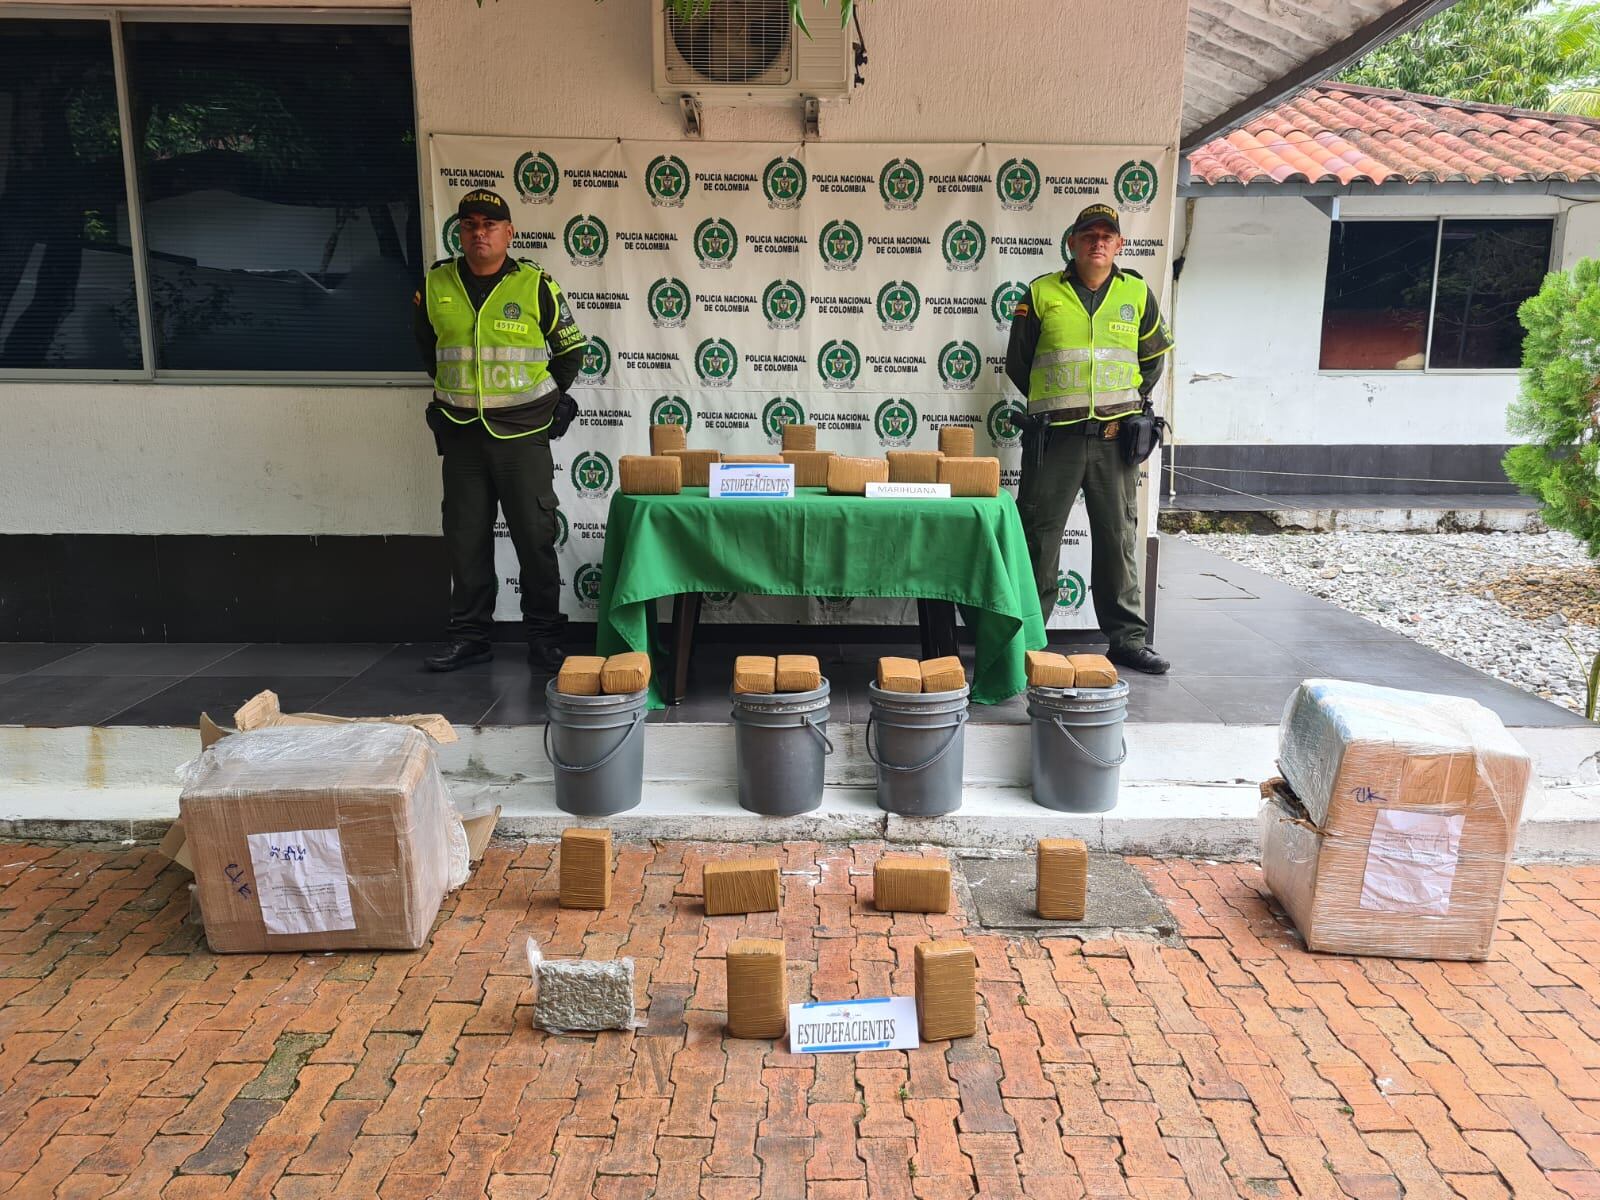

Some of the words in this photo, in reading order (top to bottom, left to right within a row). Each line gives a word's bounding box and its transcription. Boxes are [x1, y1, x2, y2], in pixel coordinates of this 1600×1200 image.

[440, 168, 468, 177] POLICIA
[469, 169, 505, 178] NACIONAL
[564, 170, 591, 178] POLICIA
[592, 170, 627, 179] NACIONAL
[695, 173, 722, 181] POLICIA
[724, 174, 758, 182] NACIONAL
[812, 174, 839, 183] POLICIA
[840, 175, 875, 183] NACIONAL
[929, 175, 956, 183] POLICIA
[958, 175, 992, 183] NACIONAL
[1045, 176, 1072, 184] POLICIA
[1074, 177, 1109, 185] NACIONAL
[449, 178, 458, 186] DE
[460, 179, 496, 187] COLOMBIA
[573, 179, 582, 187] DE
[583, 179, 619, 188] COLOMBIA
[704, 183, 713, 191] DE
[714, 183, 749, 191] COLOMBIA
[820, 184, 829, 192] DE
[831, 184, 866, 192] COLOMBIA
[937, 185, 946, 193] DE
[948, 184, 983, 192] COLOMBIA
[1053, 186, 1063, 194] DE
[1064, 186, 1099, 194] COLOMBIA
[521, 231, 556, 240] NACIONAL
[616, 232, 643, 241] POLICIA
[644, 233, 678, 241] NACIONAL
[745, 235, 772, 243] POLICIA
[774, 236, 808, 244] NACIONAL
[868, 236, 895, 245] POLICIA
[896, 237, 931, 245] NACIONAL
[991, 236, 1017, 245] POLICIA
[1018, 238, 1052, 246] NACIONAL
[1132, 239, 1164, 247] NACIONAL
[512, 241, 548, 249] COLOMBIA
[624, 242, 634, 250] DE
[635, 242, 670, 250] COLOMBIA
[754, 245, 763, 253] DE
[764, 245, 799, 253] COLOMBIA
[876, 246, 885, 254] DE
[887, 246, 922, 254] COLOMBIA
[999, 246, 1008, 254] DE
[1009, 247, 1044, 255] COLOMBIA
[1124, 248, 1156, 256] COLOMBIA
[567, 292, 594, 300] POLICIA
[596, 292, 629, 300] NACIONAL
[696, 294, 722, 303] POLICIA
[724, 295, 757, 303] NACIONAL
[810, 296, 837, 304] POLICIA
[925, 297, 952, 305] POLICIA
[953, 297, 987, 305] NACIONAL
[576, 301, 585, 309] DE
[587, 301, 621, 310] COLOMBIA
[704, 304, 713, 312] DE
[714, 304, 749, 312] COLOMBIA
[819, 305, 827, 313] DE
[829, 306, 864, 314] COLOMBIA
[933, 306, 942, 314] DE
[943, 306, 979, 314] COLOMBIA
[618, 352, 644, 360] POLICIA
[646, 352, 680, 360] NACIONAL
[773, 355, 807, 363] NACIONAL
[866, 356, 892, 364] POLICIA
[893, 356, 926, 364] NACIONAL
[986, 356, 1007, 364] POLIC
[627, 361, 636, 369] DE
[637, 361, 672, 369] COLOMBIA
[764, 364, 798, 372] COLOMBIA
[874, 365, 882, 373] DE
[884, 365, 918, 373] COLOMBIA
[994, 366, 1003, 374] DE
[599, 410, 632, 418] NACIONAL
[724, 412, 758, 420] NACIONAL
[809, 413, 835, 421] POLICIA
[837, 413, 870, 421] NACIONAL
[922, 414, 948, 422] POLICIA
[949, 414, 983, 422] NACIONAL
[580, 418, 588, 426] DE
[590, 418, 623, 426] COLOMBIA
[705, 420, 714, 428] DE
[715, 421, 749, 429] COLOMBIA
[817, 422, 826, 430] DE
[828, 422, 862, 430] COLOMBIA
[930, 423, 939, 431] DE
[720, 478, 790, 492] ESTUPEFACIENTES
[877, 485, 937, 495] MARIHUANA
[573, 522, 599, 530] POLICIA
[581, 531, 590, 539] DE
[1064, 529, 1088, 537] CIONAL
[797, 1018, 896, 1045] ESTUPEFACIENTES
